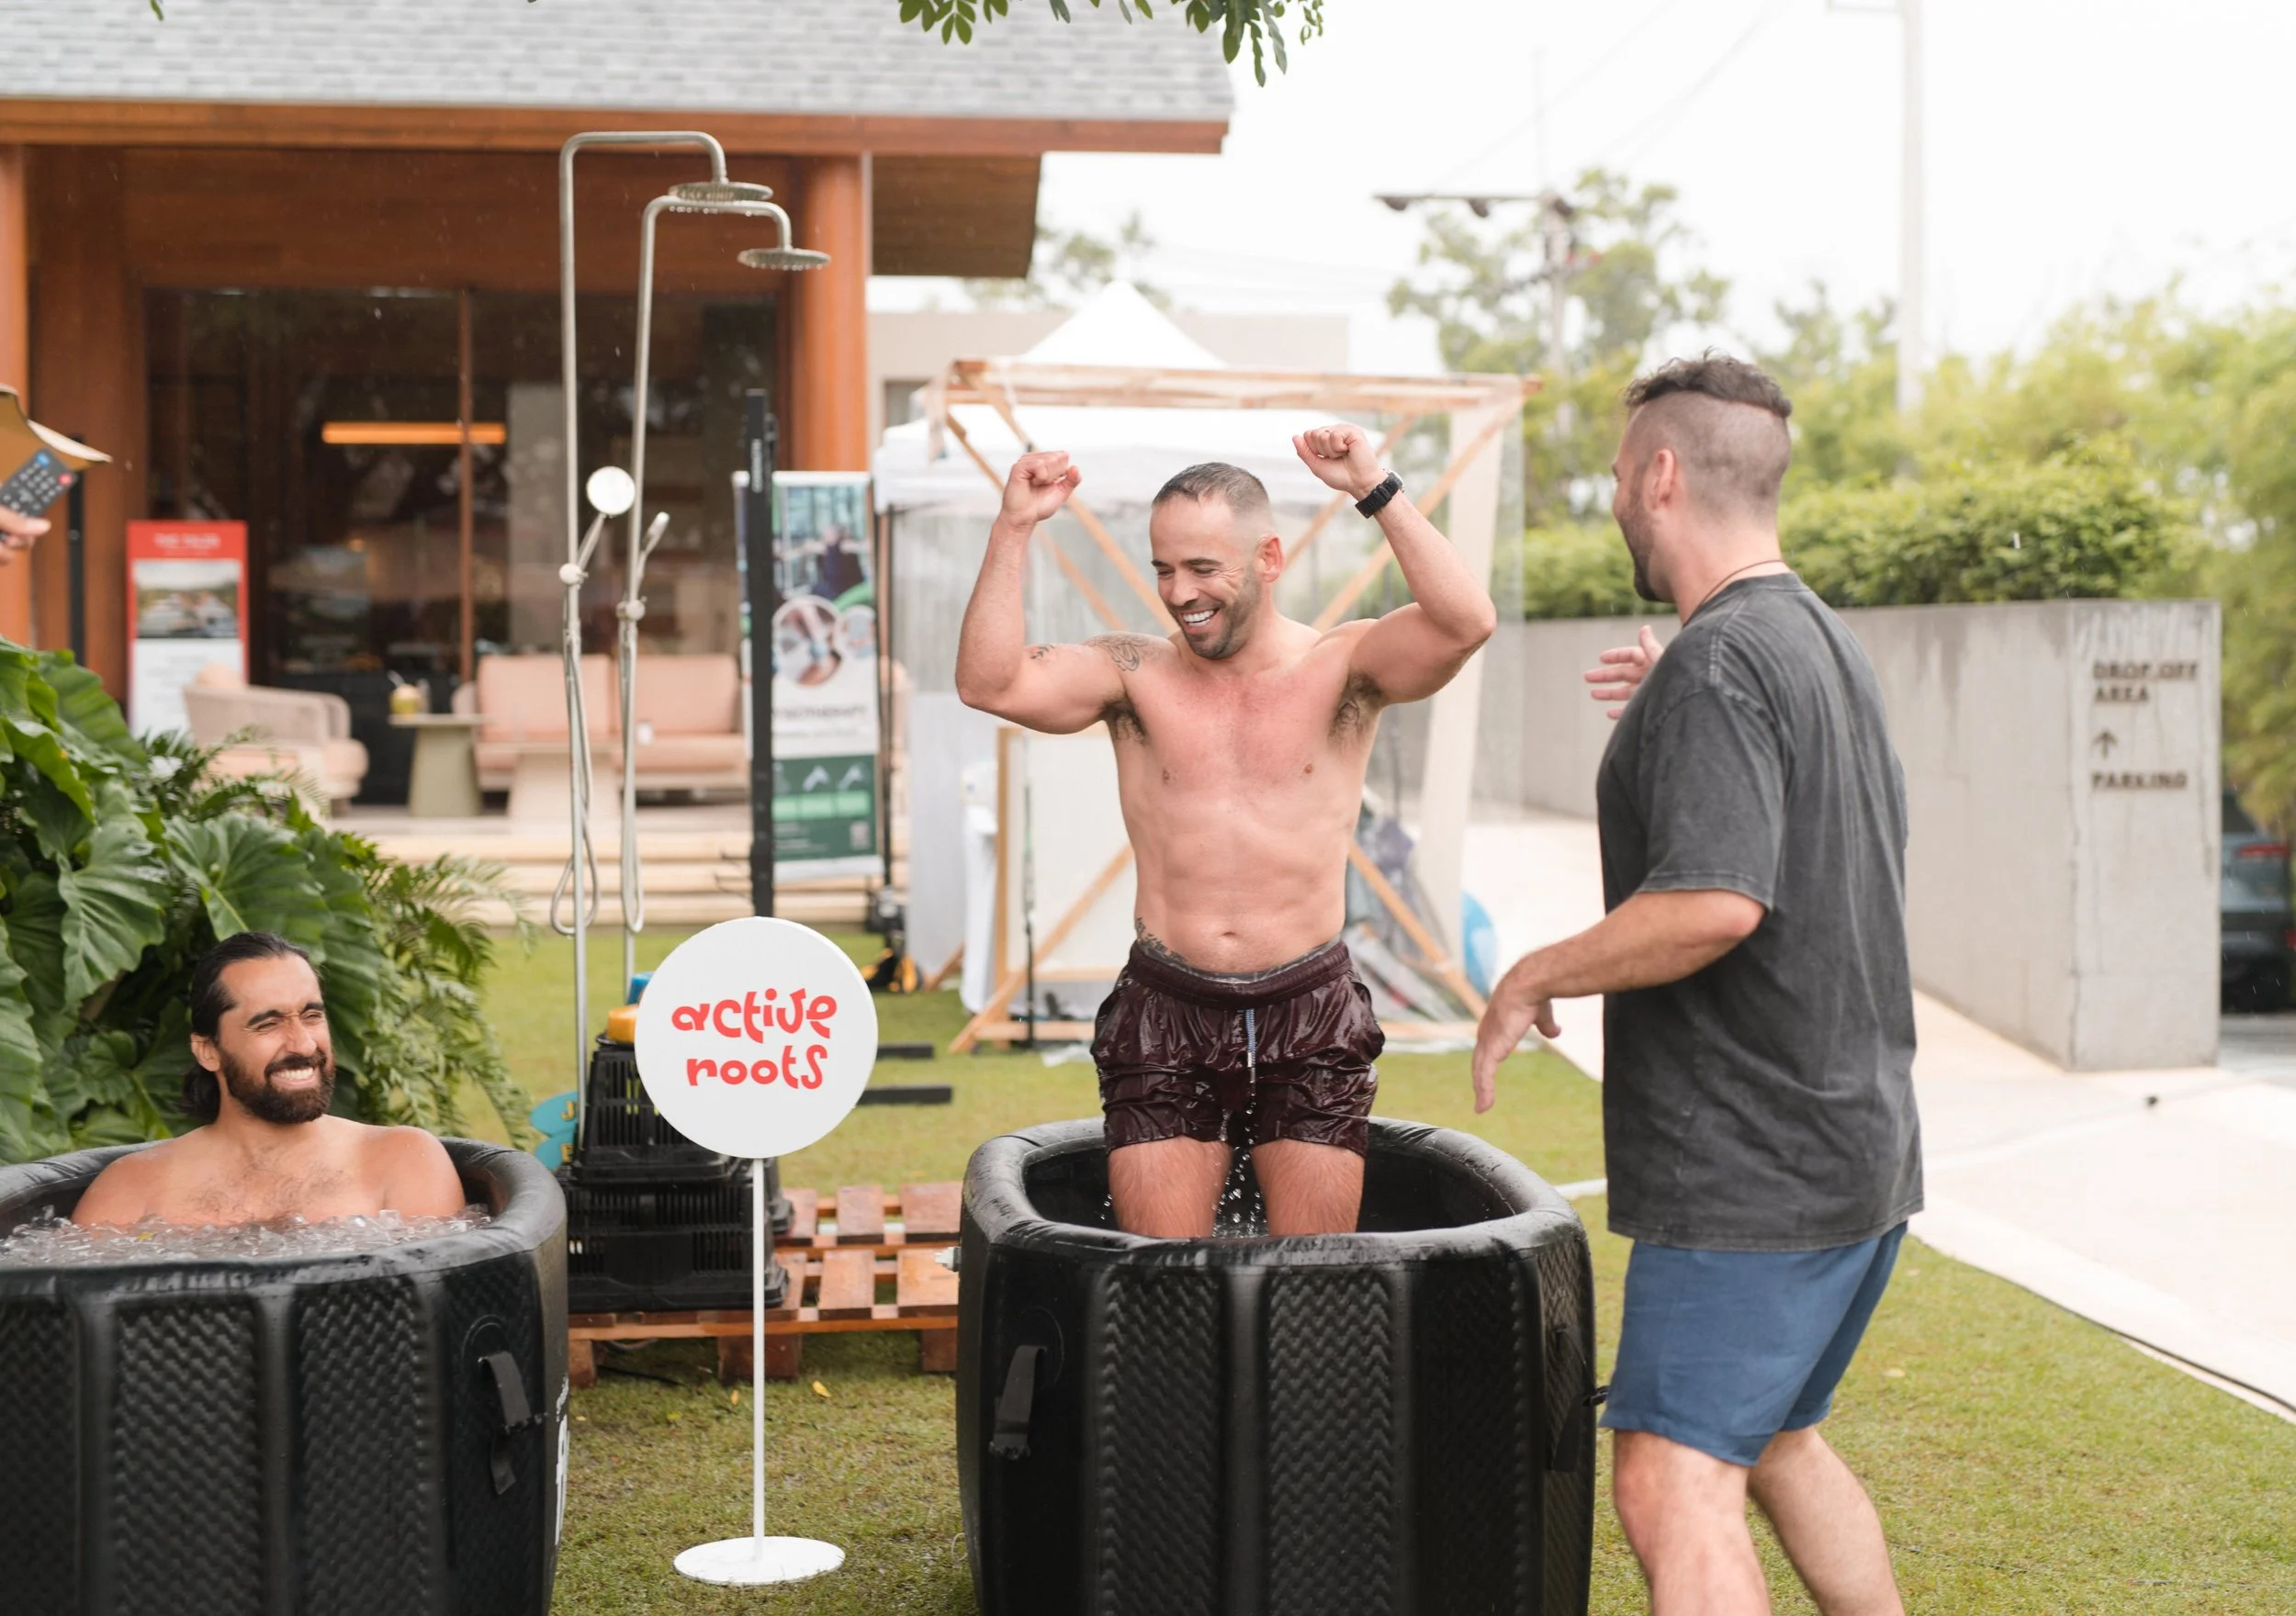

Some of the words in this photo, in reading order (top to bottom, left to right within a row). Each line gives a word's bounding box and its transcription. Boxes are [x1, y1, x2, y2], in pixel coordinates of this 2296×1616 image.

[2093, 660, 2150, 679] DROP
[2159, 660, 2198, 679] OFF
[2095, 687, 2149, 703] AREA
[2092, 771, 2188, 791] PARKING
[671, 988, 838, 1043] active
[687, 1044, 828, 1090] roots
